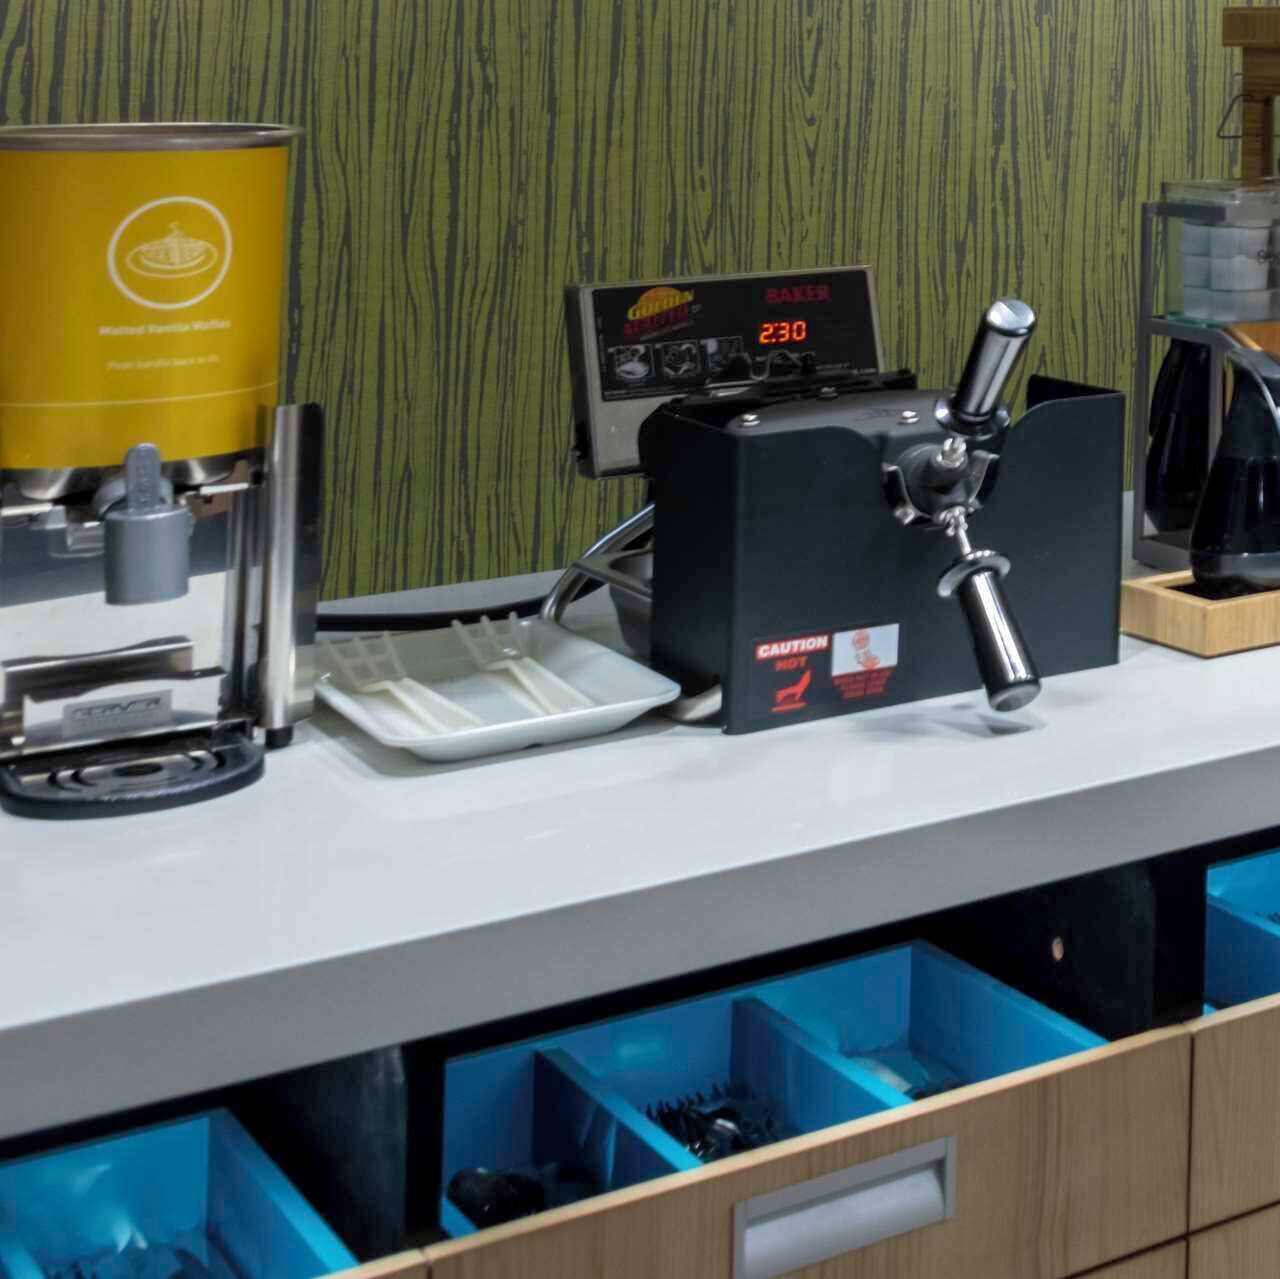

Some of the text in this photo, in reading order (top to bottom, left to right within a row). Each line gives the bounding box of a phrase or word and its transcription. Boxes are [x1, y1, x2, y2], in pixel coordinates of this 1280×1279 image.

[757, 320, 807, 345] 2:30
[756, 634, 830, 659] CAUTION
[774, 655, 808, 671] HOT
